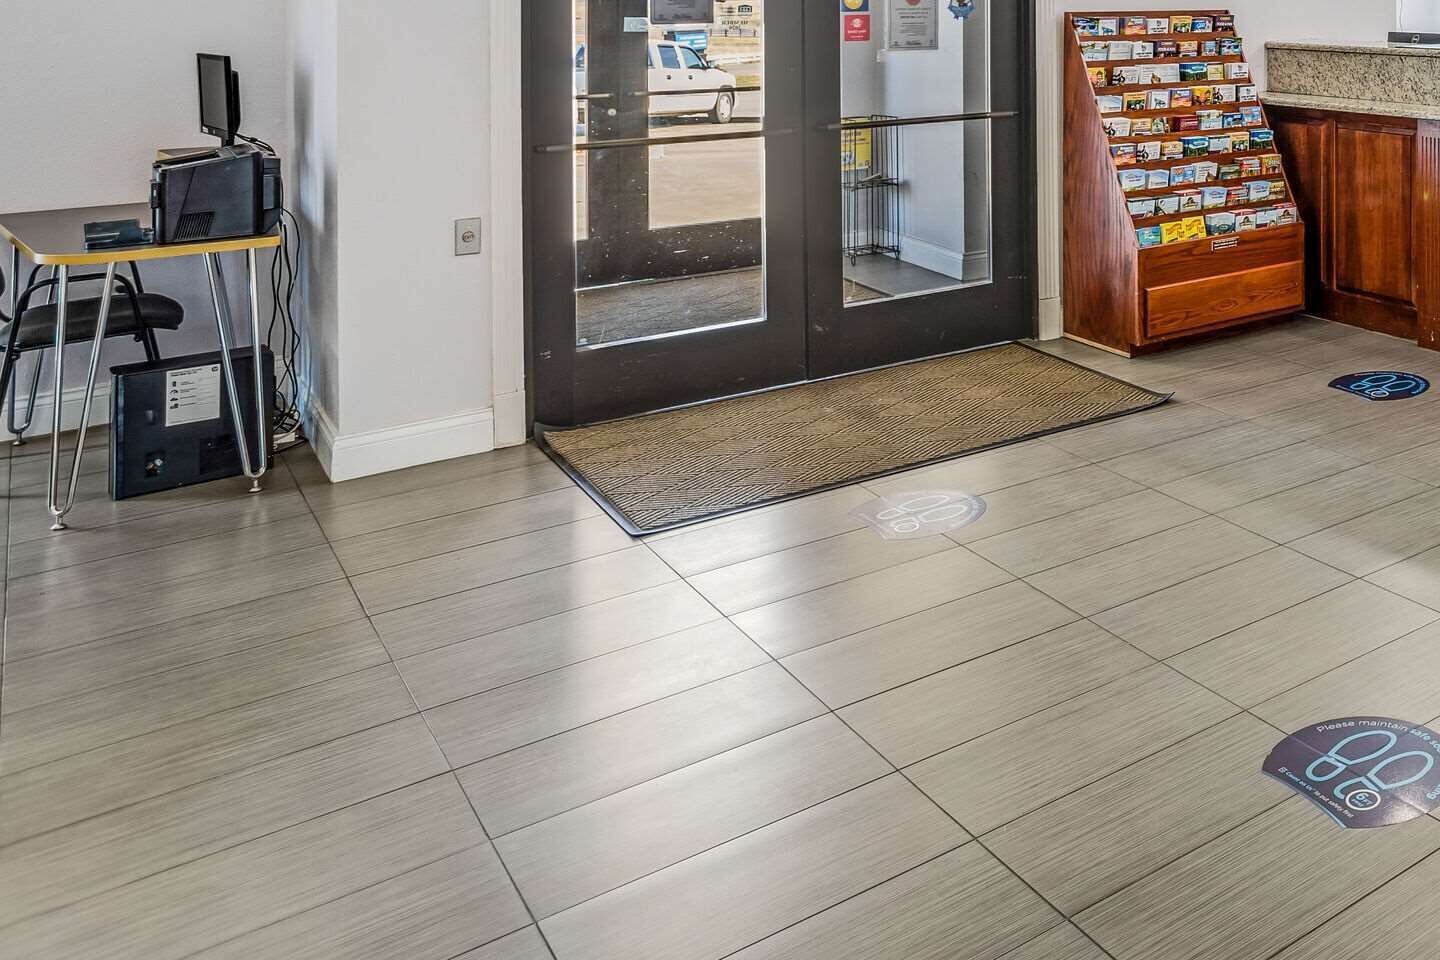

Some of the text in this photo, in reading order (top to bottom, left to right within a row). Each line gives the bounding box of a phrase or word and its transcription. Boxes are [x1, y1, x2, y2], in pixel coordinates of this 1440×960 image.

[1316, 721, 1355, 732] Please
[1358, 720, 1409, 732] maintain
[1409, 728, 1431, 741] safe
